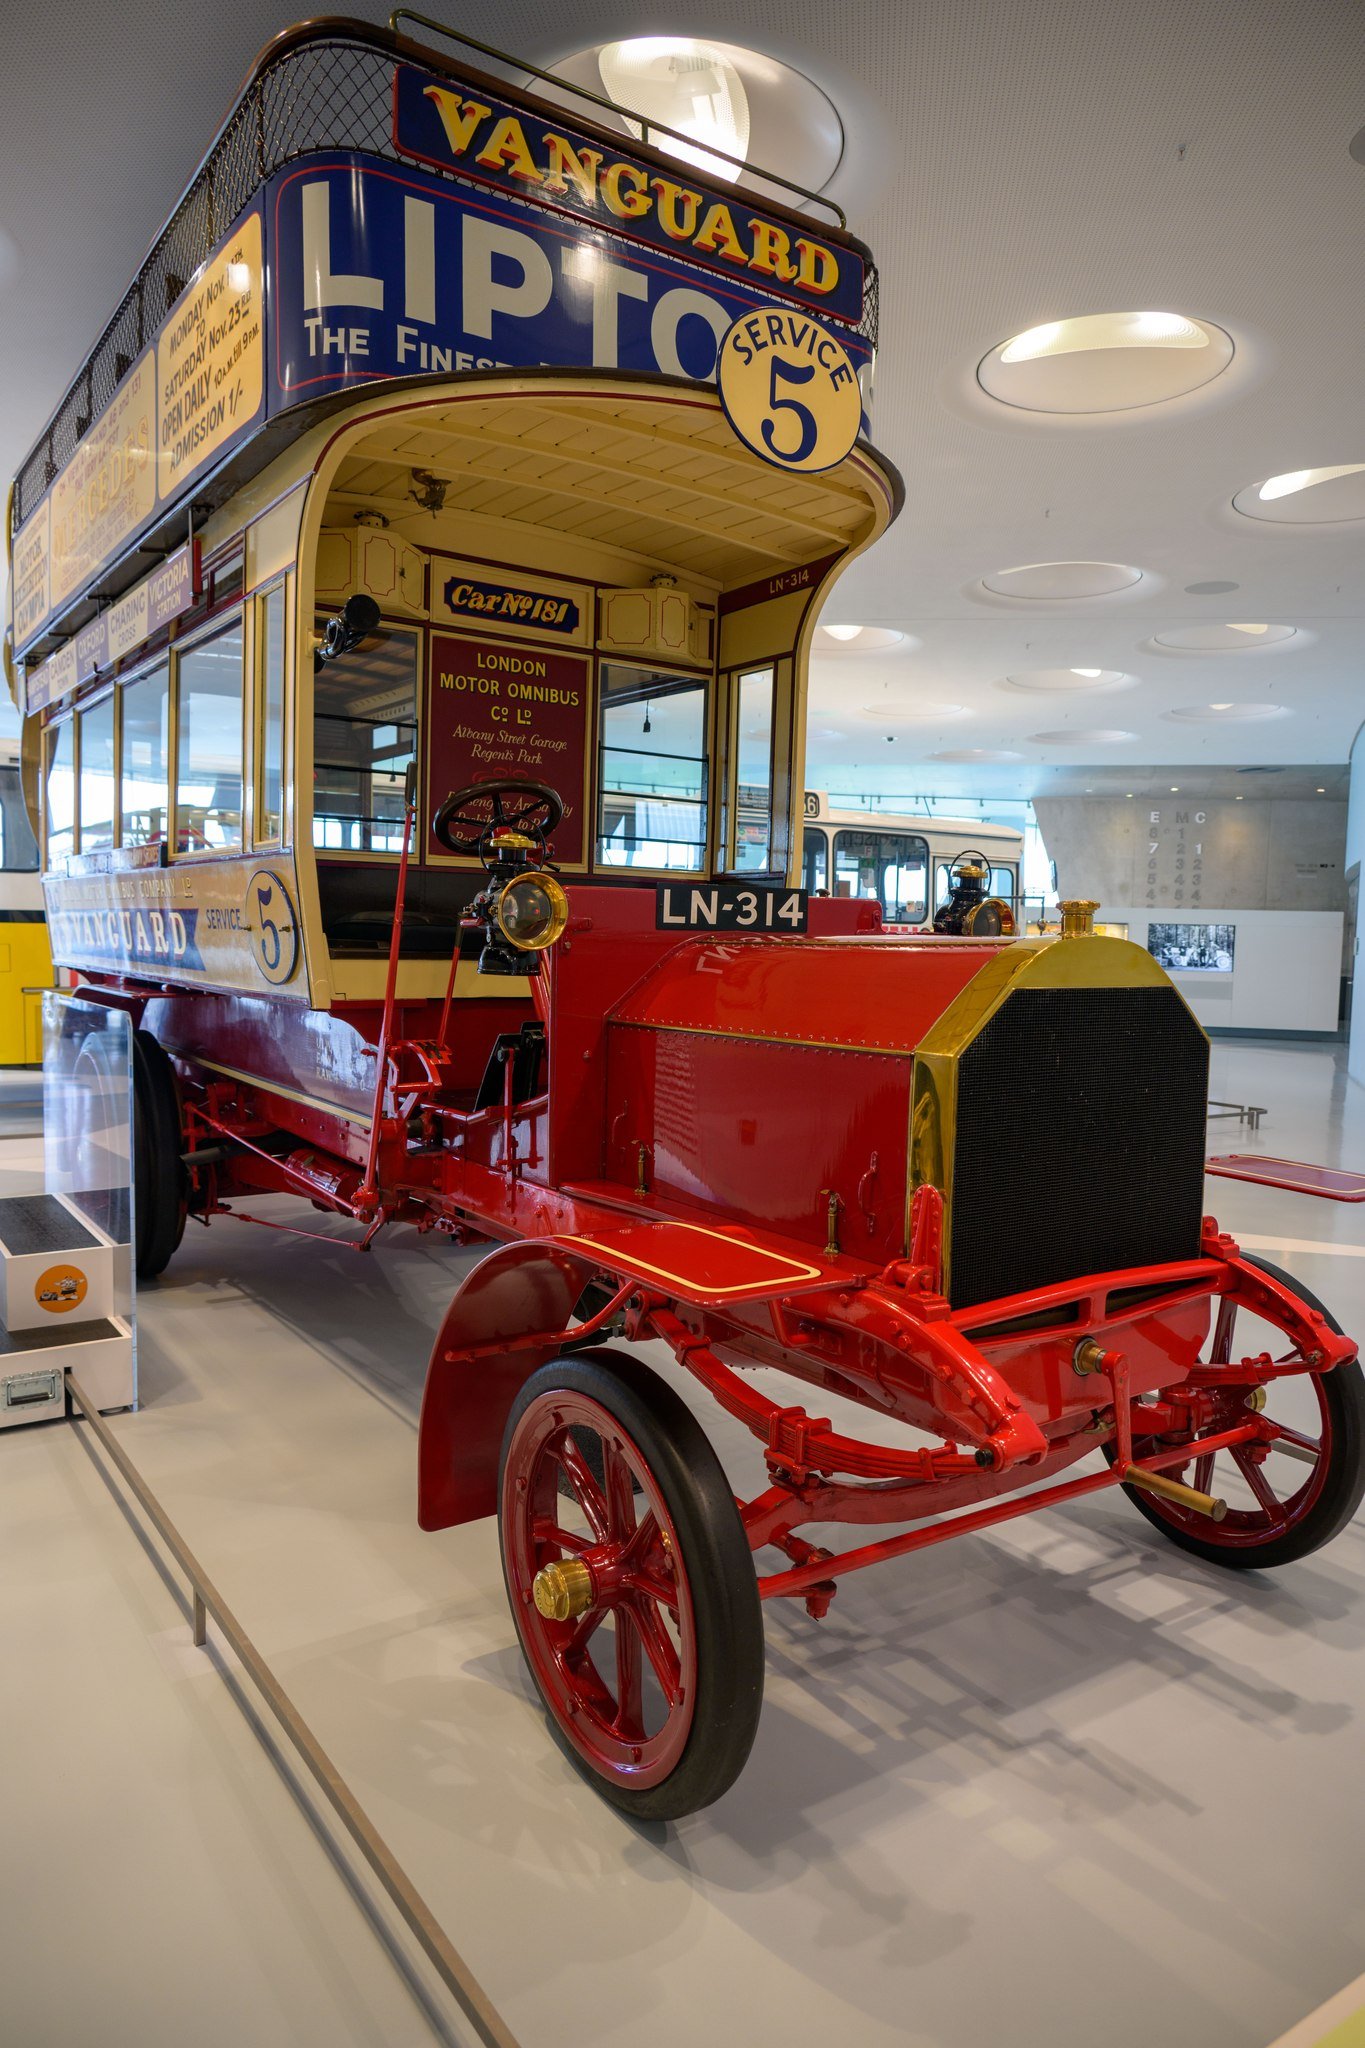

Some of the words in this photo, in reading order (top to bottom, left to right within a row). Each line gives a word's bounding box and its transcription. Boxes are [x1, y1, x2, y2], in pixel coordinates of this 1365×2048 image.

[423, 85, 839, 296] VANGUARD
[302, 181, 734, 384] LIPTO
[169, 292, 205, 359] MONDAY
[196, 318, 206, 343] TO
[304, 316, 370, 357] THE
[397, 324, 513, 373] FINES
[164, 335, 207, 406] SATURDAY
[732, 315, 854, 393] SERVICE
[162, 399, 182, 447] OPEN
[185, 364, 212, 421] DAILY
[761, 355, 818, 463] 5
[169, 396, 226, 473] ADMISSION
[148, 556, 189, 606] VICTORIA
[770, 569, 809, 594] LN-314
[18, 583, 45, 635] OLYMPIA
[111, 591, 145, 635] CHARING
[156, 588, 181, 620] STATION
[451, 584, 501, 613] Car
[530, 598, 569, 625] 181
[79, 623, 105, 660] OXFORD
[118, 624, 136, 648] CROSS
[51, 649, 76, 681] CAMDEN
[477, 652, 546, 678] LONDON
[440, 672, 500, 696] MOTOR
[507, 682, 579, 707] OMNIBUS
[453, 724, 494, 744] Albany
[497, 730, 527, 746] Street
[1150, 811, 1160, 823] E
[1195, 812, 1206, 823] C
[1149, 843, 1159, 854] 7
[1195, 843, 1202, 854] 1
[139, 878, 176, 899] COMPANY
[662, 887, 804, 927] LN-314
[69, 911, 187, 960] VANGUARD
[206, 908, 241, 931] SERVICE
[257, 886, 281, 970] 5
